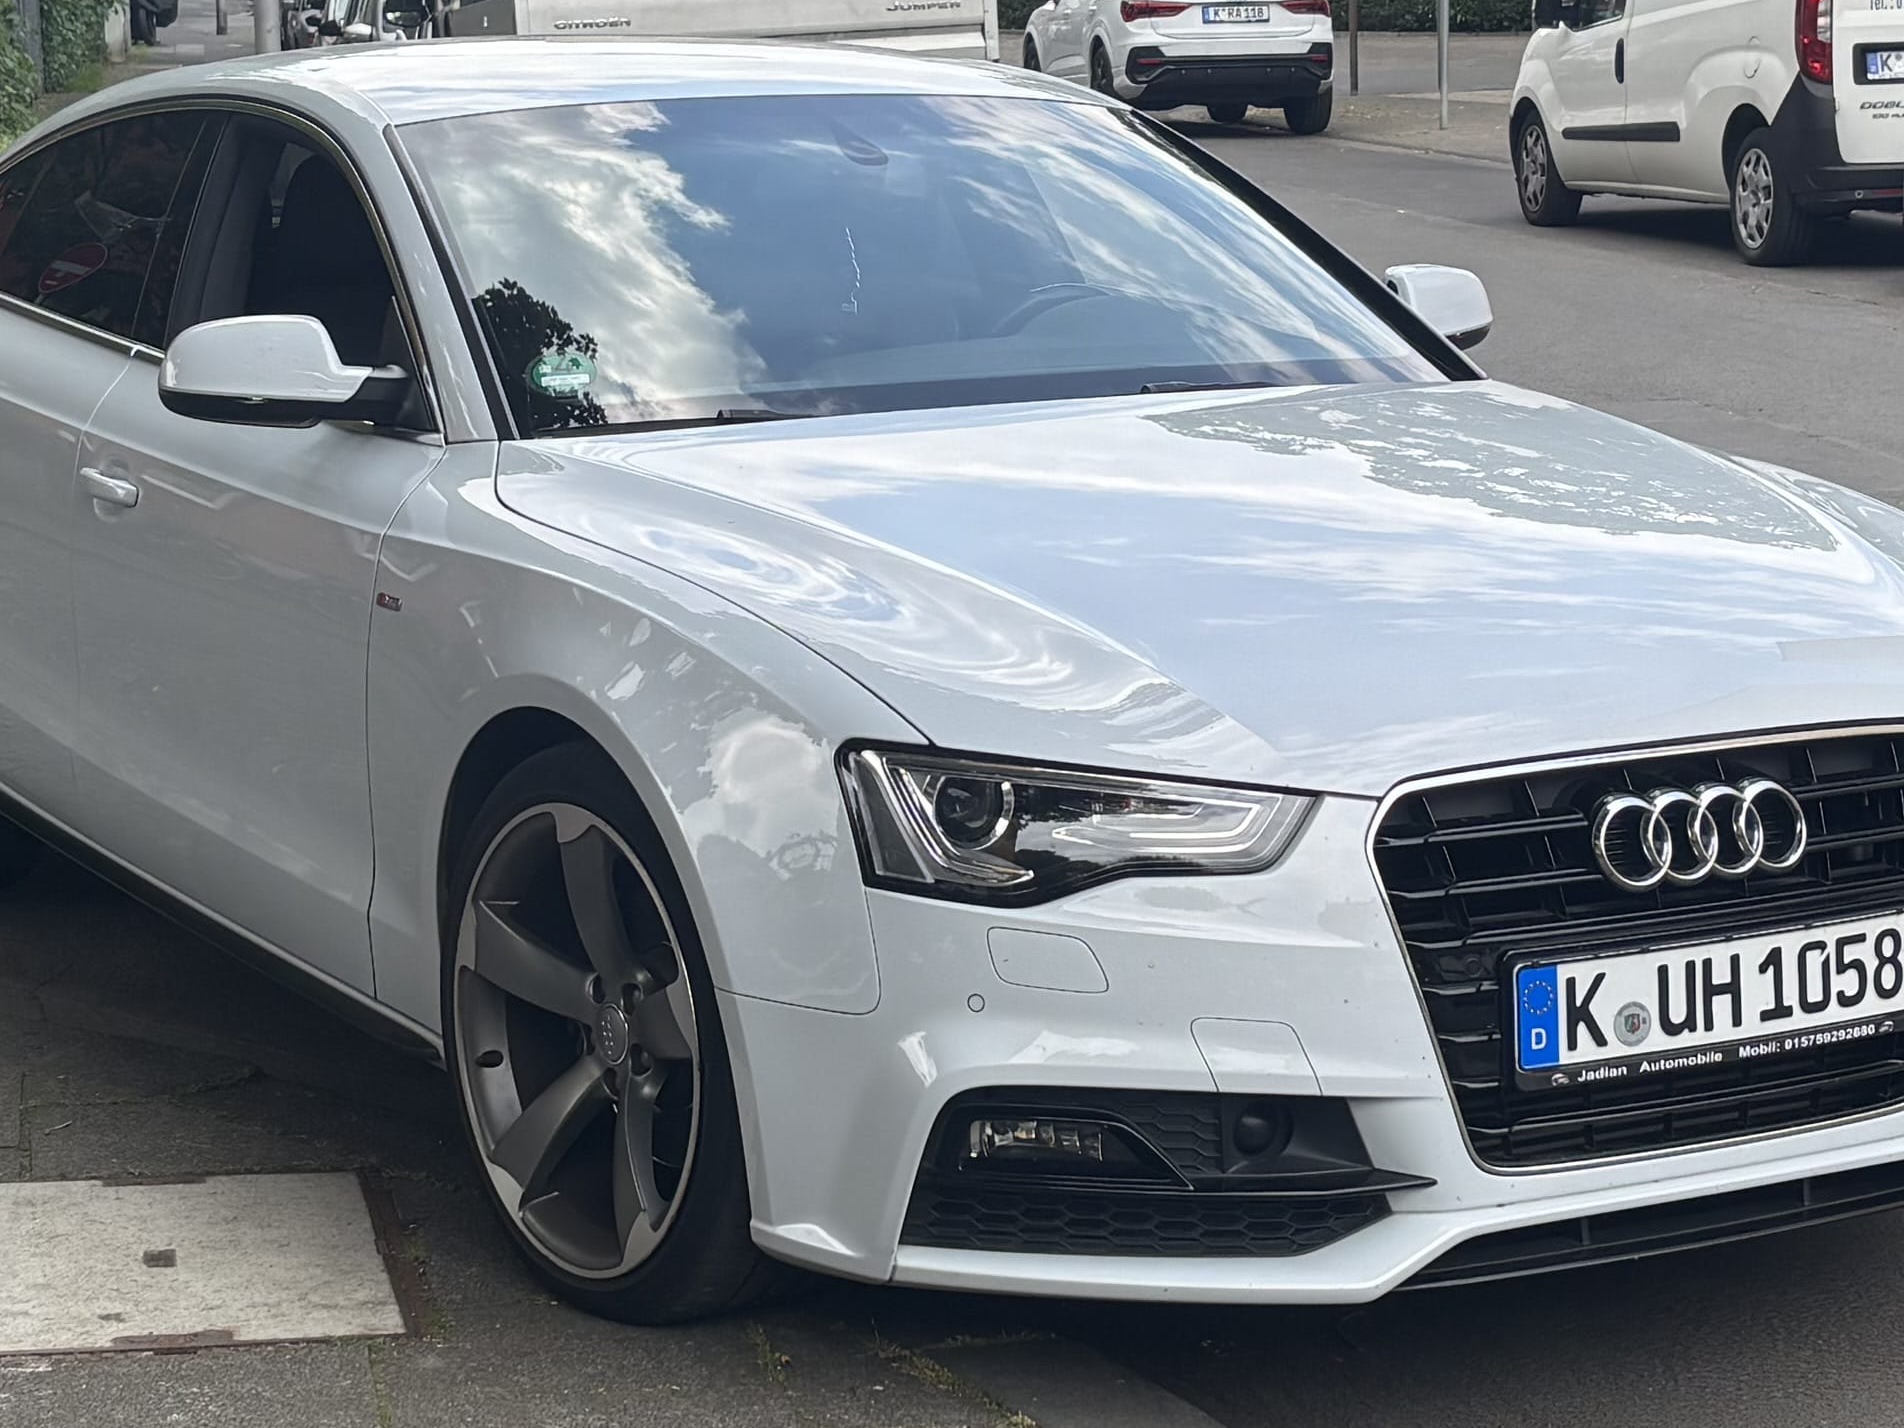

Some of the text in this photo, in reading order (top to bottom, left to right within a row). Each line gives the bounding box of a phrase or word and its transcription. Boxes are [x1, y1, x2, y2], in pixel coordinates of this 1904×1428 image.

[886, 0, 961, 11] JUMPER
[554, 16, 631, 29] CITROËN
[1880, 54, 1893, 72] K
[1566, 928, 1903, 1051] K UH 1058
[1531, 1029, 1546, 1050] D
[1640, 1050, 1723, 1073] Automobile
[1739, 1039, 1781, 1059] Mobil:
